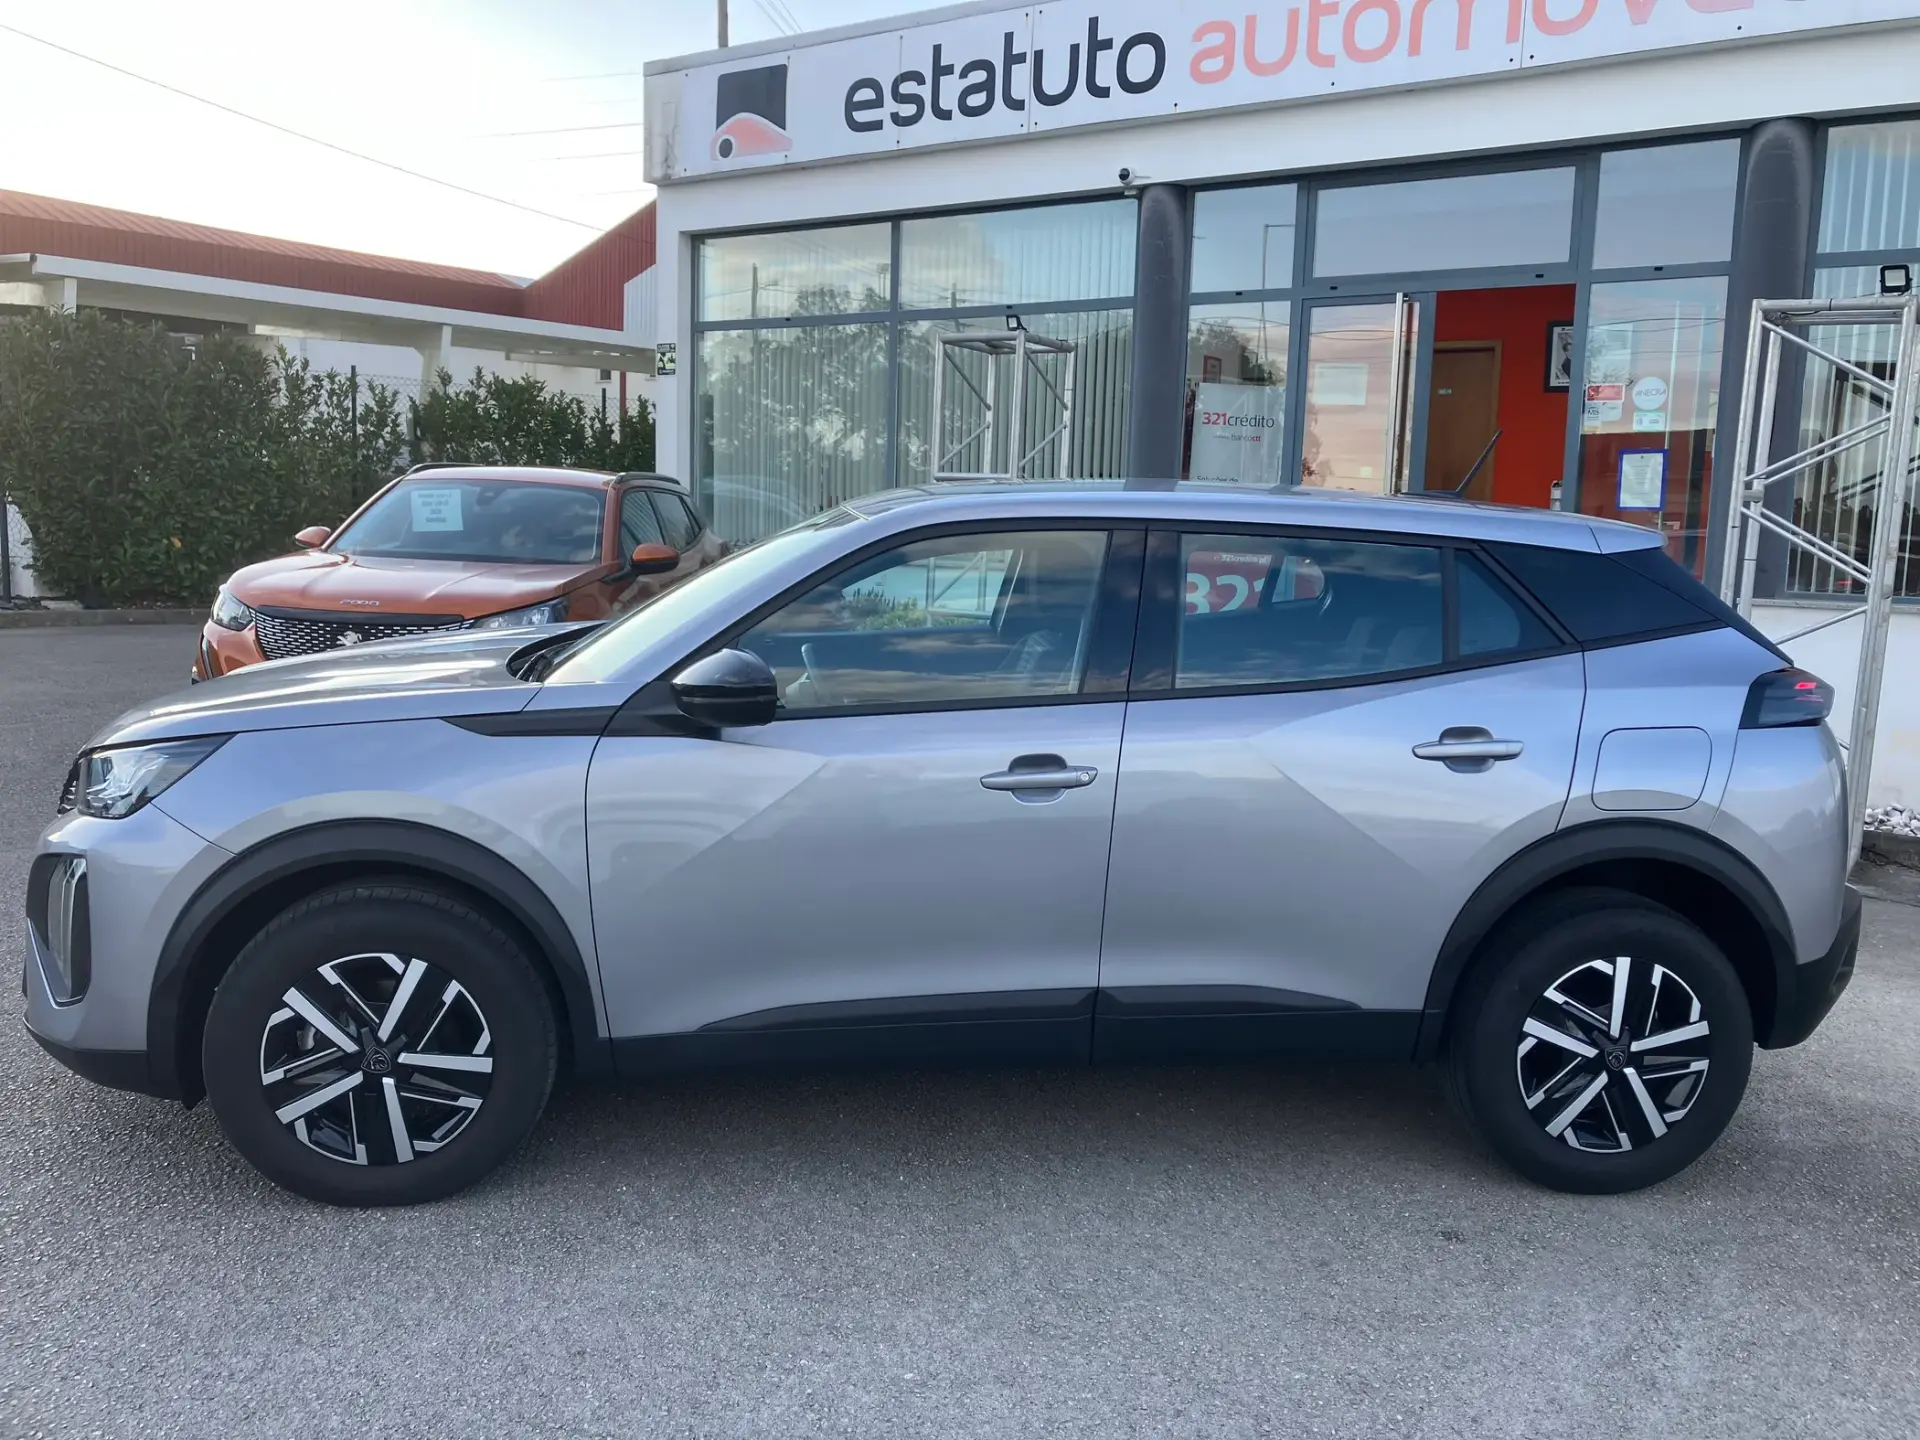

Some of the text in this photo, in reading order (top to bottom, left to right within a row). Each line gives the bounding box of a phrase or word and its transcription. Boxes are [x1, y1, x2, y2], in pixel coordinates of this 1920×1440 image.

[844, 16, 1166, 132] estatuto
[1634, 388, 1667, 397] ANECRA
[1202, 412, 1275, 428] 321crédito
